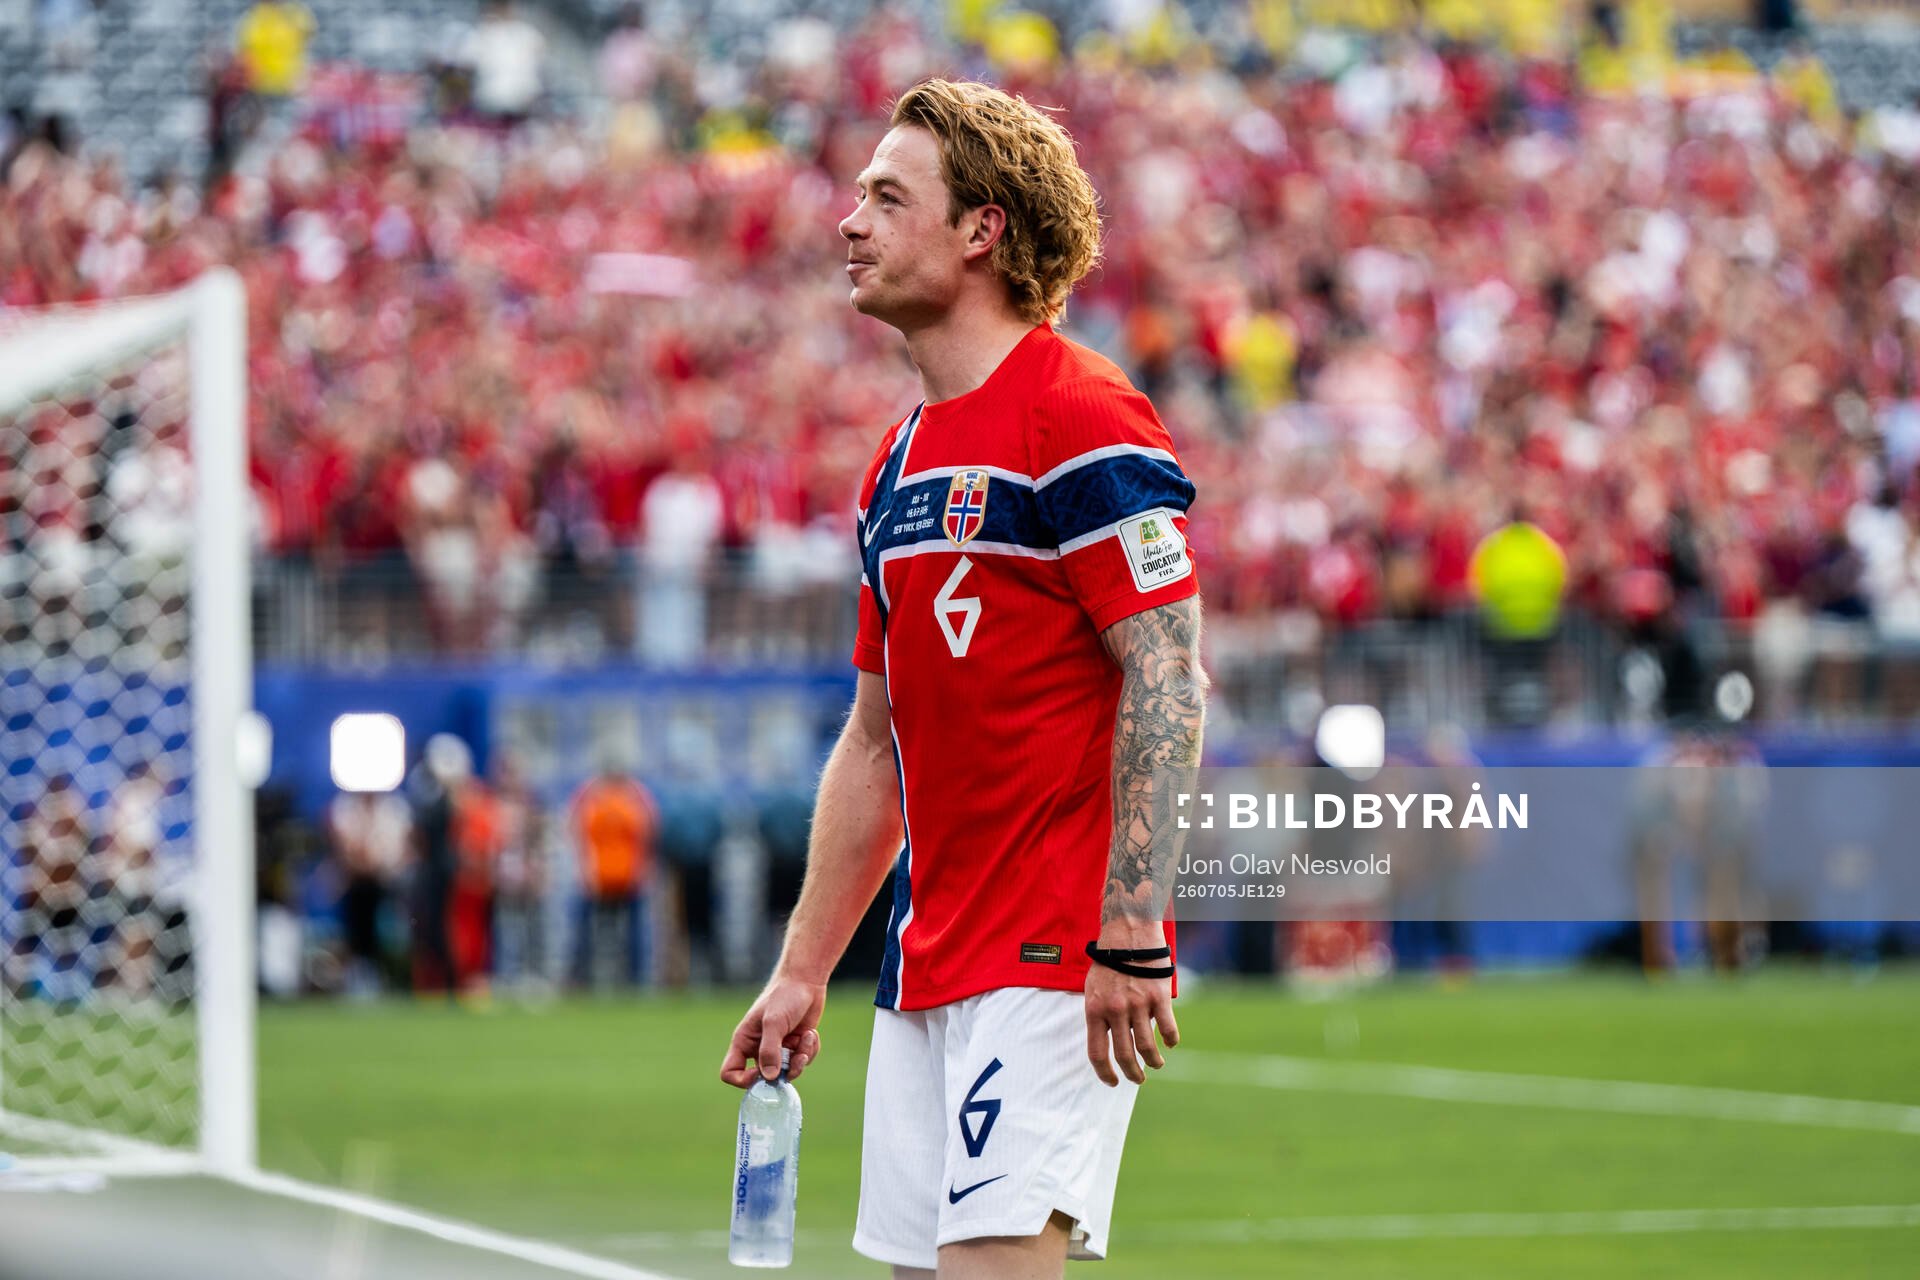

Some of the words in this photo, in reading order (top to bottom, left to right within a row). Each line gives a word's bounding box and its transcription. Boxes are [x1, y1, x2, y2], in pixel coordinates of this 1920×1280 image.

[1141, 550, 1182, 575] EDUCATION
[1143, 545, 1163, 560] Unite
[1158, 567, 1175, 578] FIFA
[933, 554, 983, 658] 6
[958, 1057, 1004, 1158] 6
[736, 1160, 749, 1205] 100%
